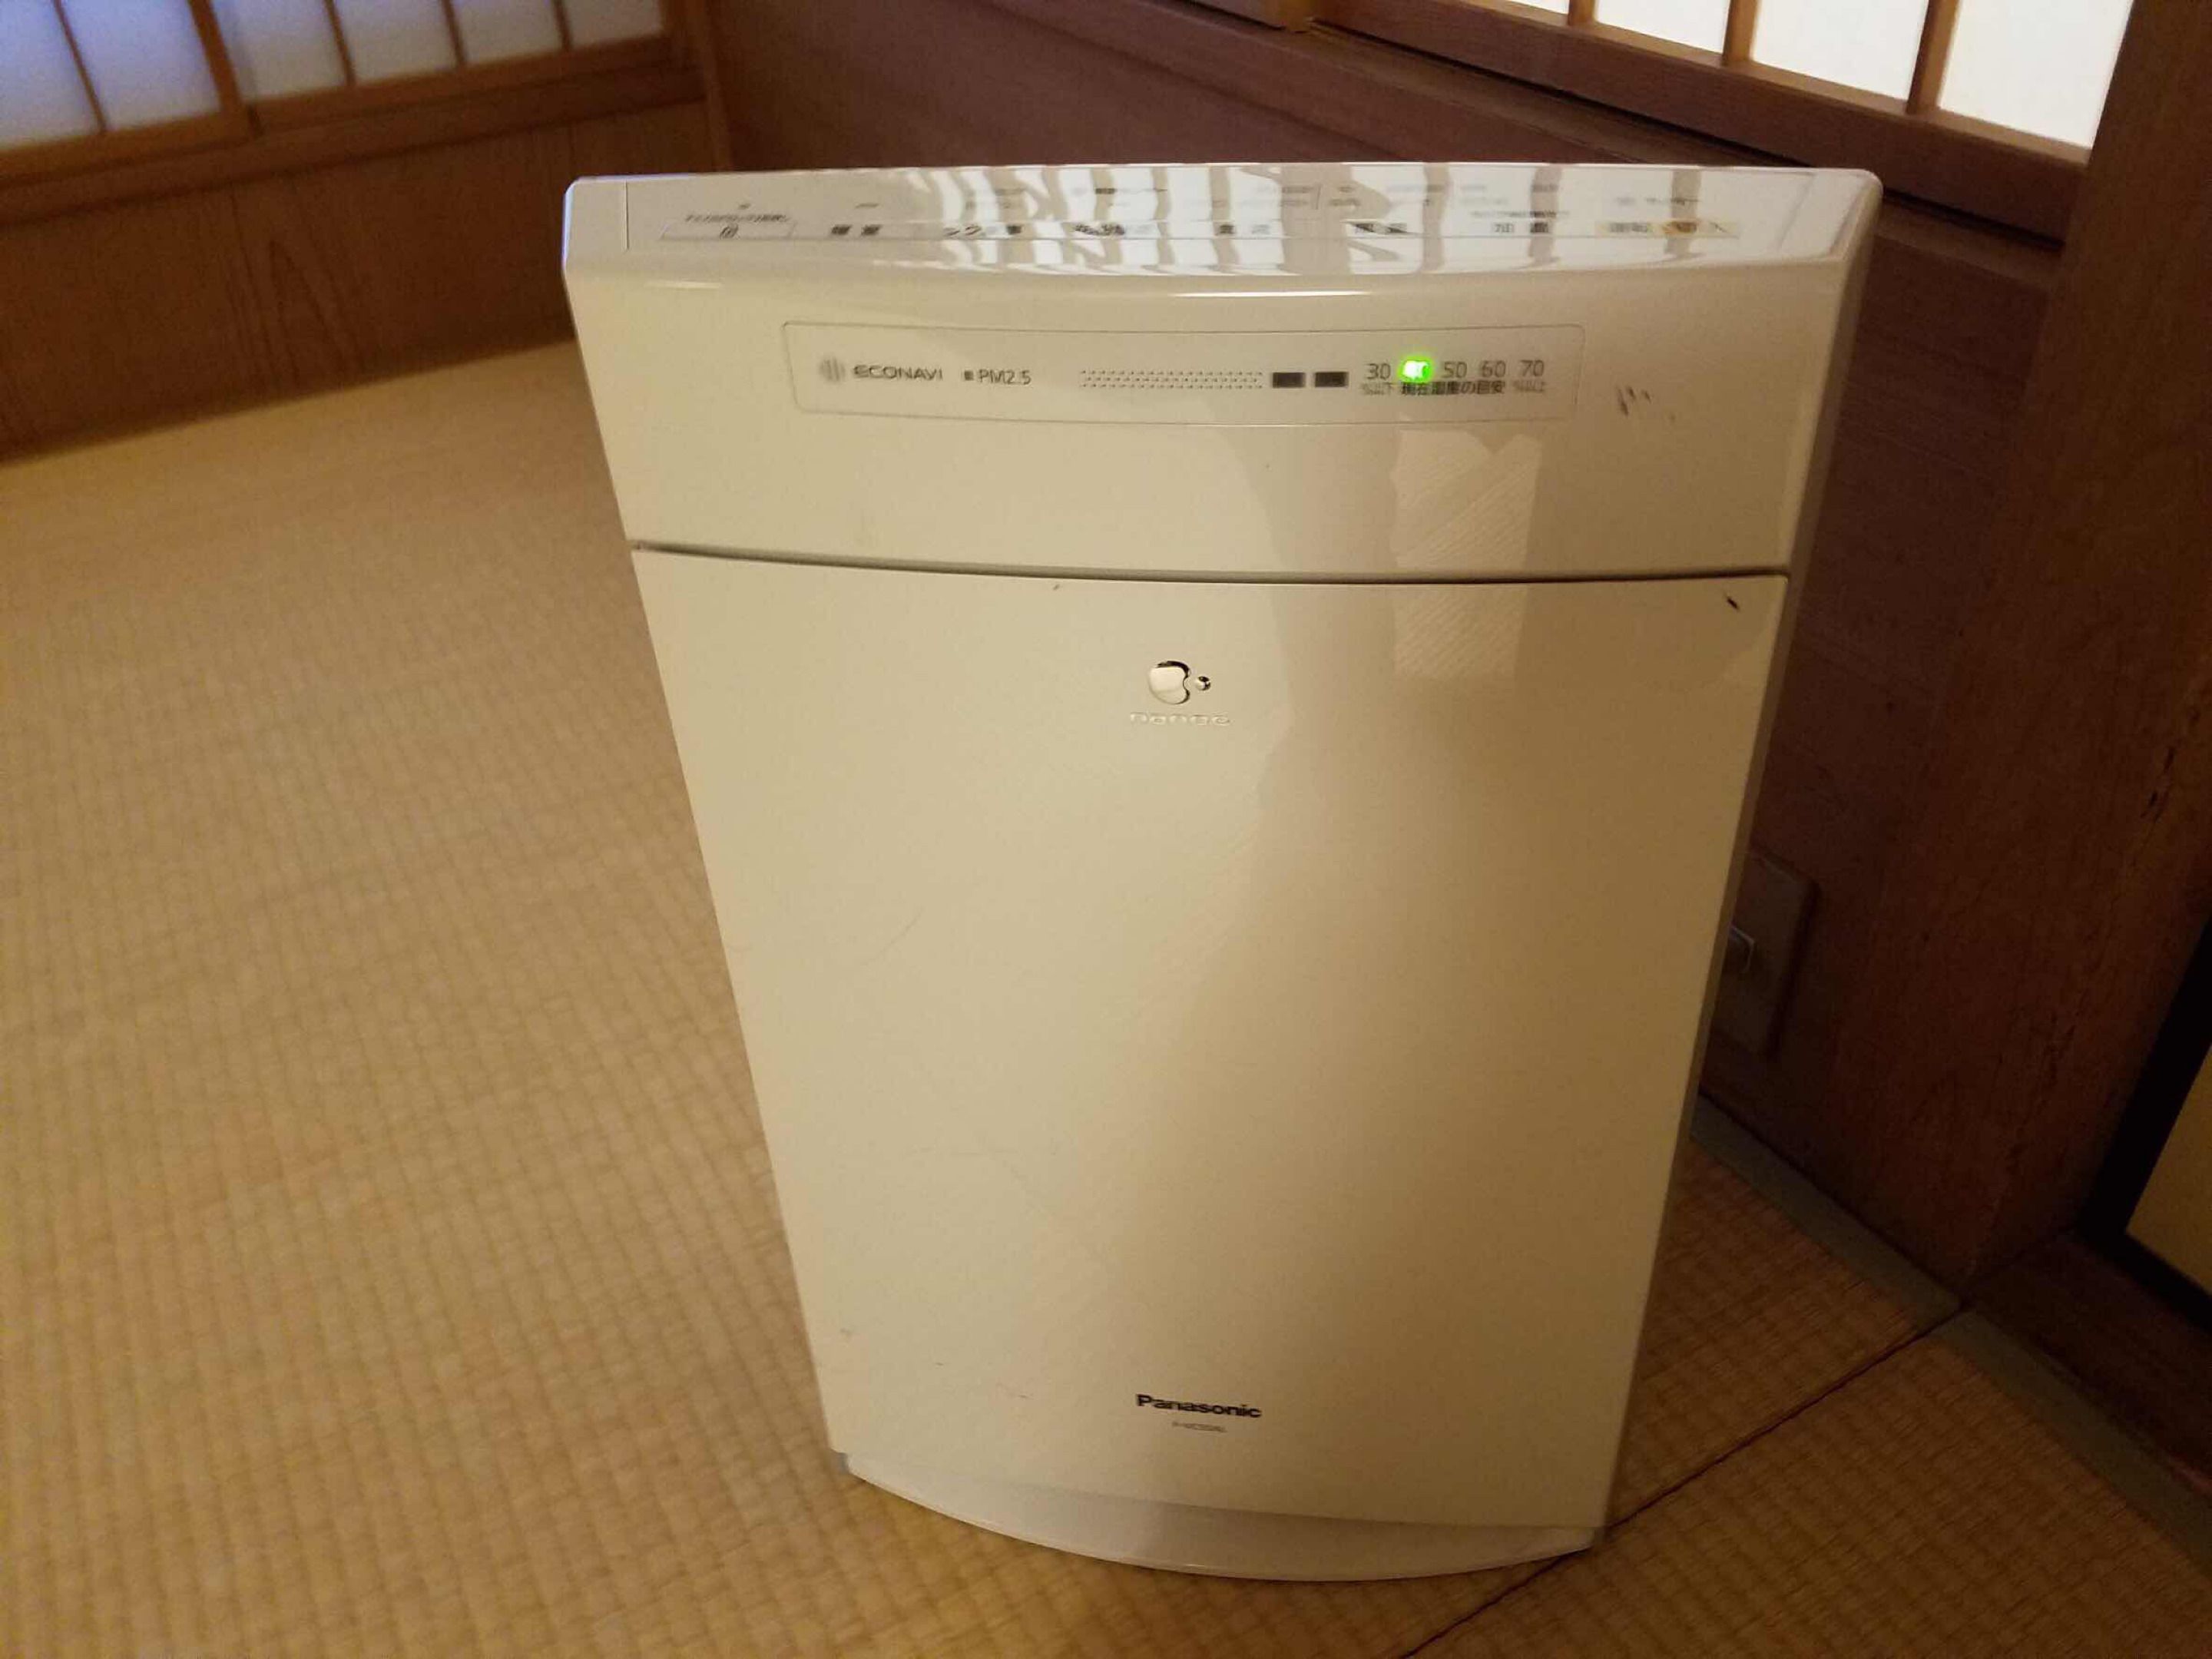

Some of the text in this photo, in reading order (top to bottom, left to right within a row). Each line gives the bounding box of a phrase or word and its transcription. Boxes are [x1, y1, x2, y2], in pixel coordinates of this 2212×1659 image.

[853, 364, 944, 379] ECONAVI
[1366, 363, 1392, 380] 30
[1443, 360, 1468, 379] 50
[1481, 359, 1506, 378] 60
[1520, 359, 1545, 377] 70
[1137, 1393, 1262, 1419] Panasonic
